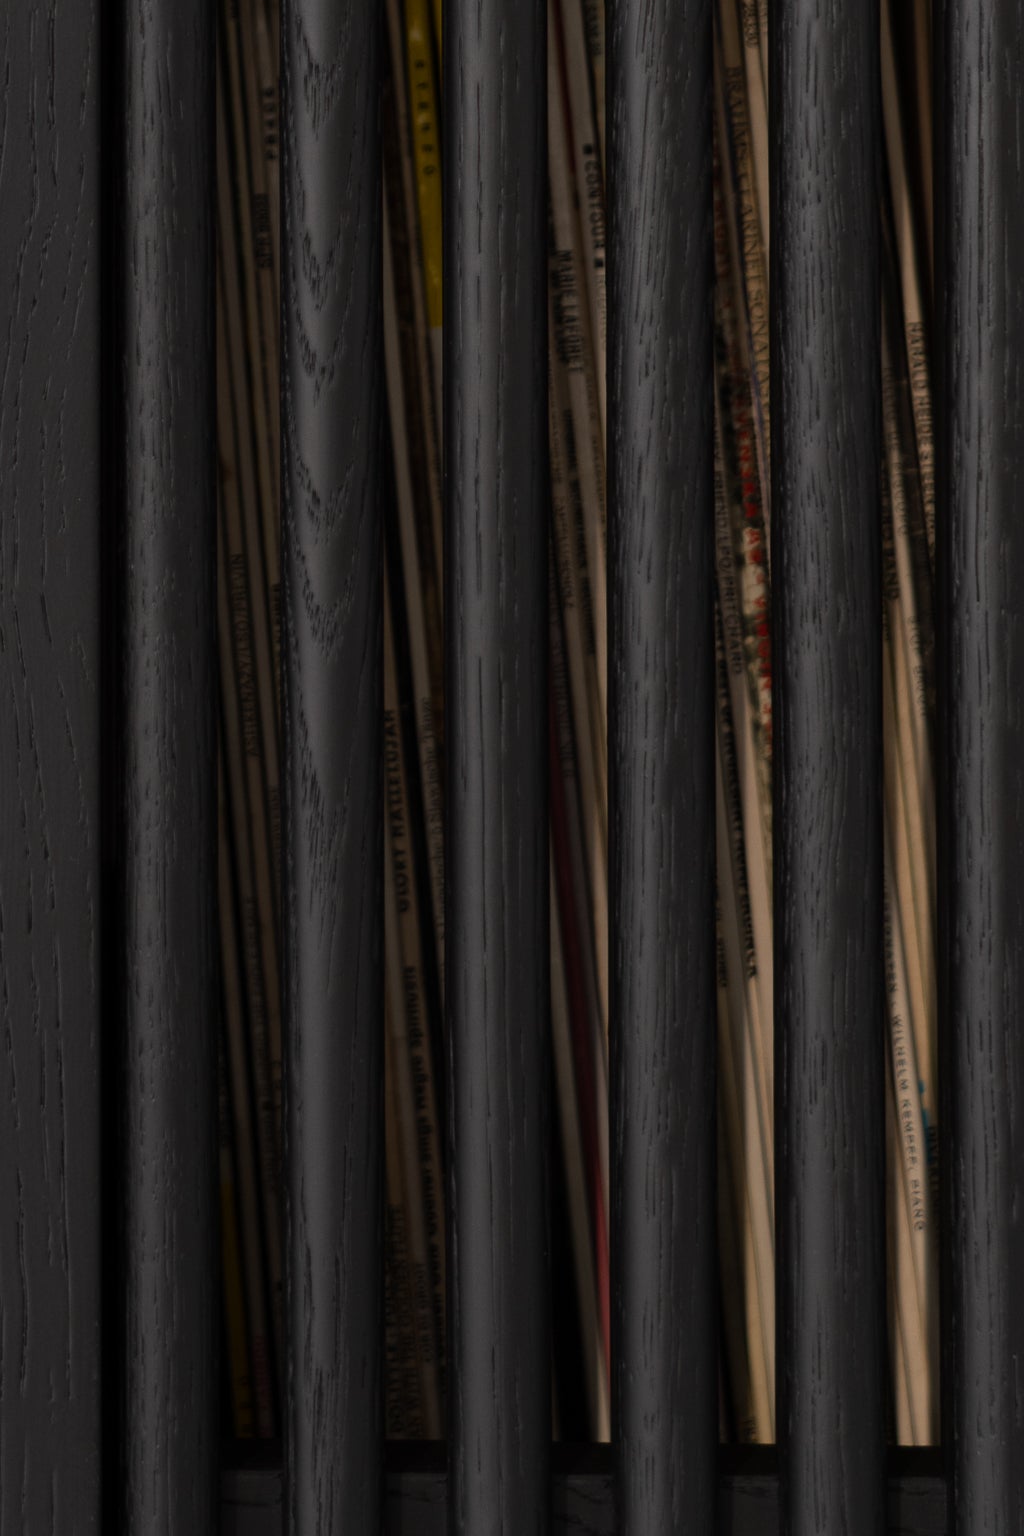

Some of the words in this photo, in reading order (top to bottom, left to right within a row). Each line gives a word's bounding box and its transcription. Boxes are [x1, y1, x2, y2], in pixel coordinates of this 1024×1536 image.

[584, 160, 606, 249] CONTOUR
[557, 250, 575, 297] MARIE
[383, 709, 405, 838] HALLELUJAH
[387, 850, 410, 913] GLORY
[890, 1014, 910, 1091] WILHELM
[912, 1179, 927, 1232] PIANO
